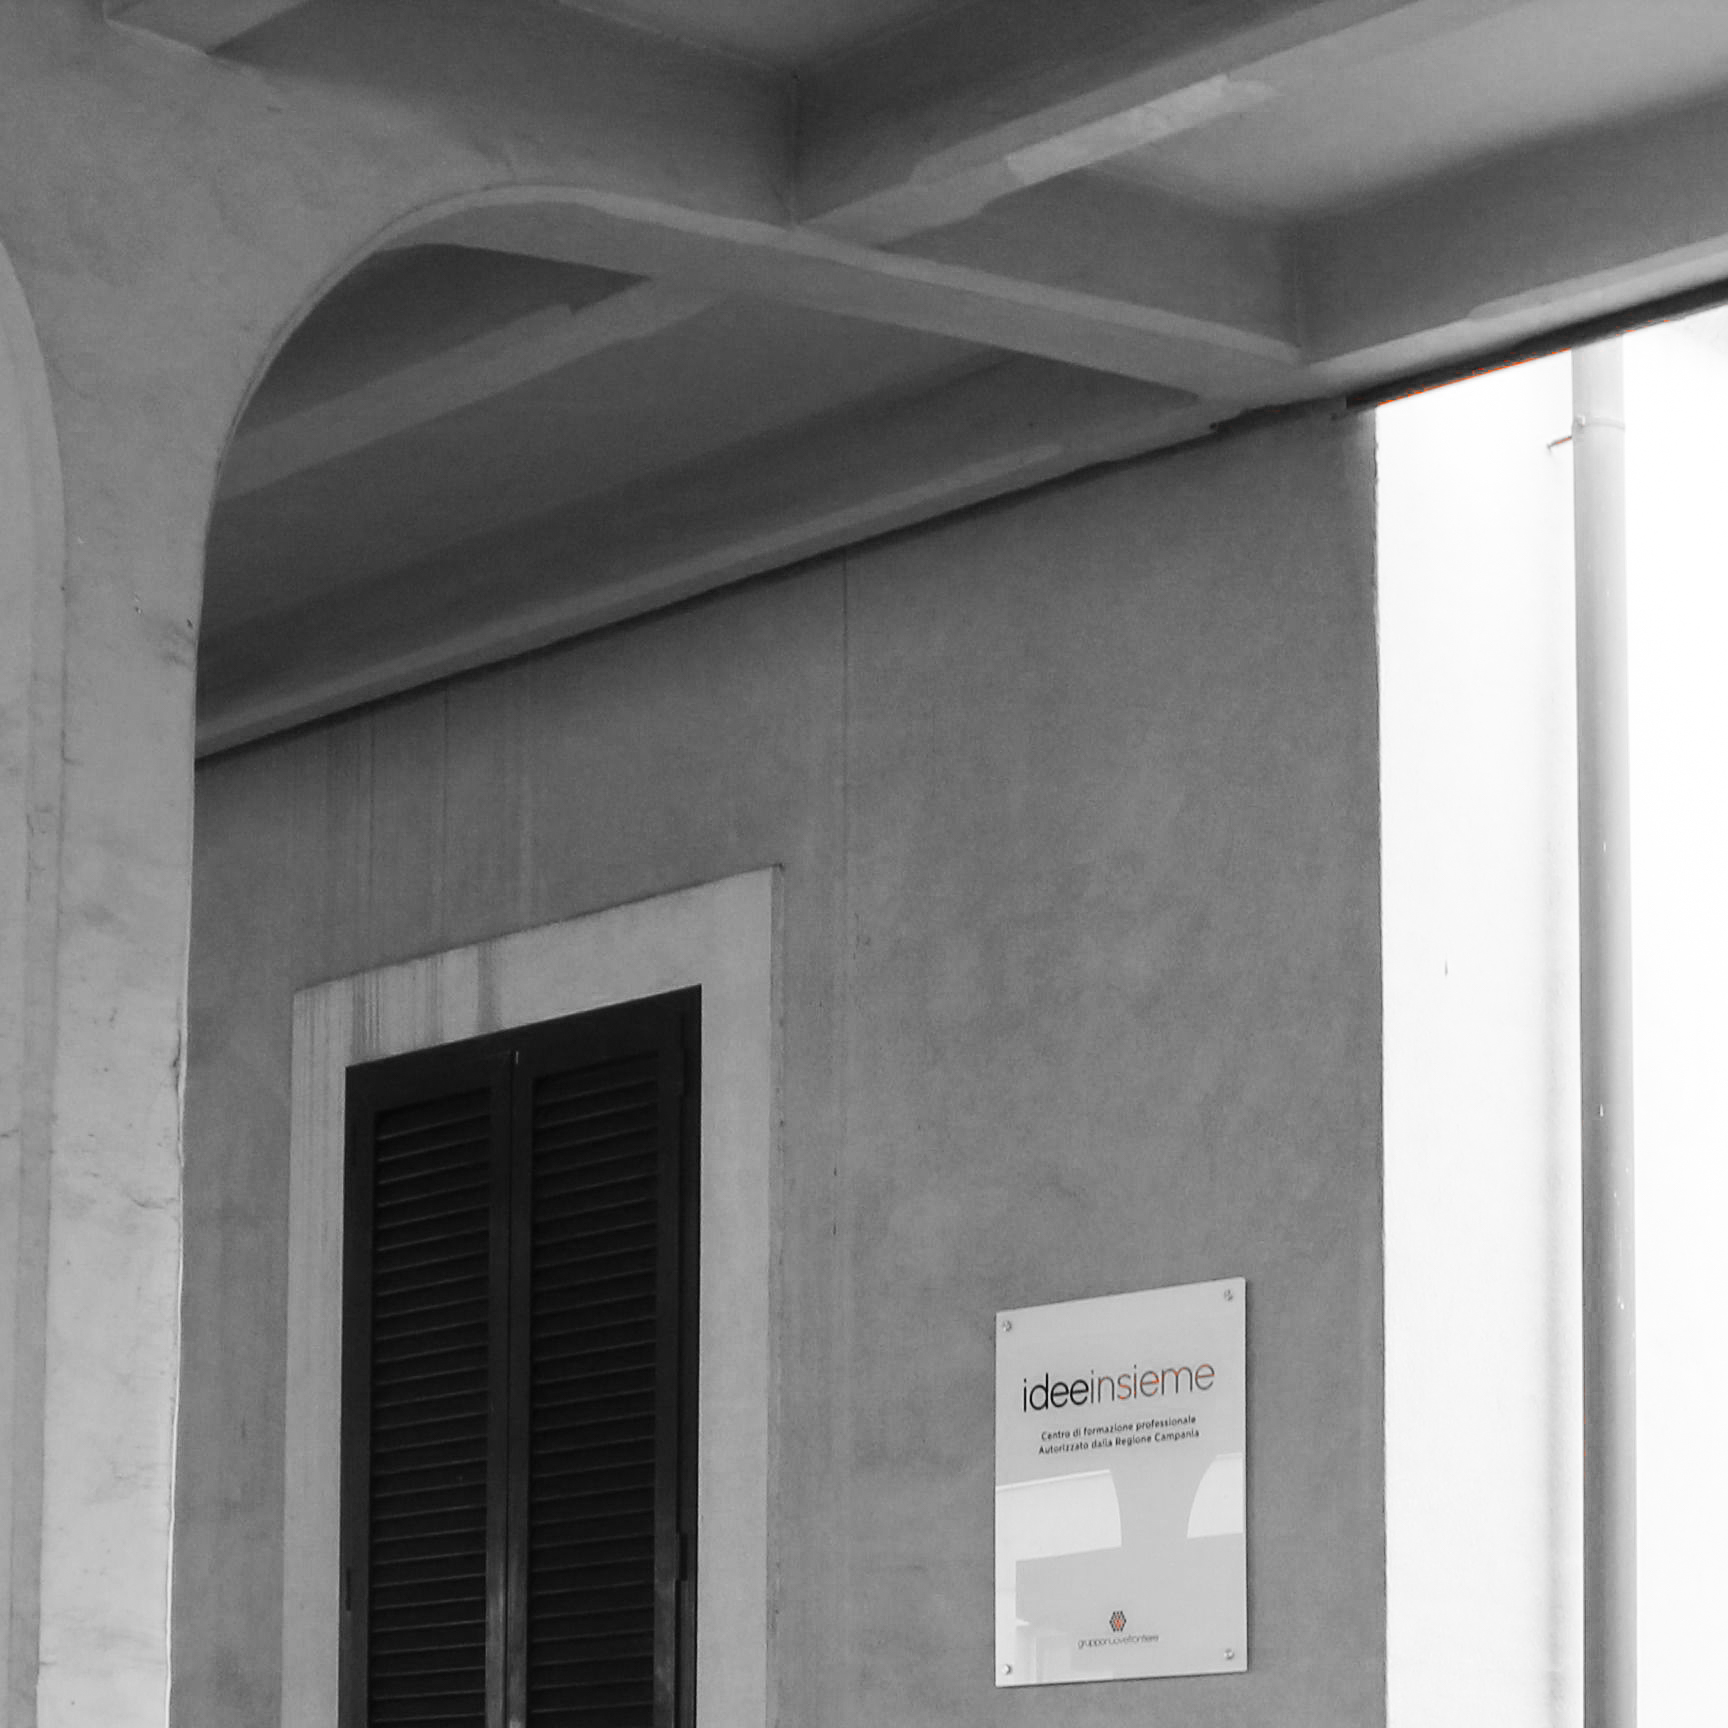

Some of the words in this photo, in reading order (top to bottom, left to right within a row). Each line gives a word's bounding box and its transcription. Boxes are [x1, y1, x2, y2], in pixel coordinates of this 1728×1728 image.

[1023, 1364, 1216, 1413] ideeinsieme
[1038, 1439, 1089, 1455] Autorizzato
[1091, 1438, 1113, 1449] dalla
[1115, 1433, 1152, 1447] Regione
[1154, 1427, 1200, 1443] Campania
[1041, 1430, 1071, 1441] Centro
[1073, 1428, 1082, 1438] di
[1083, 1422, 1134, 1437] formazione
[1135, 1414, 1197, 1431] professionale
